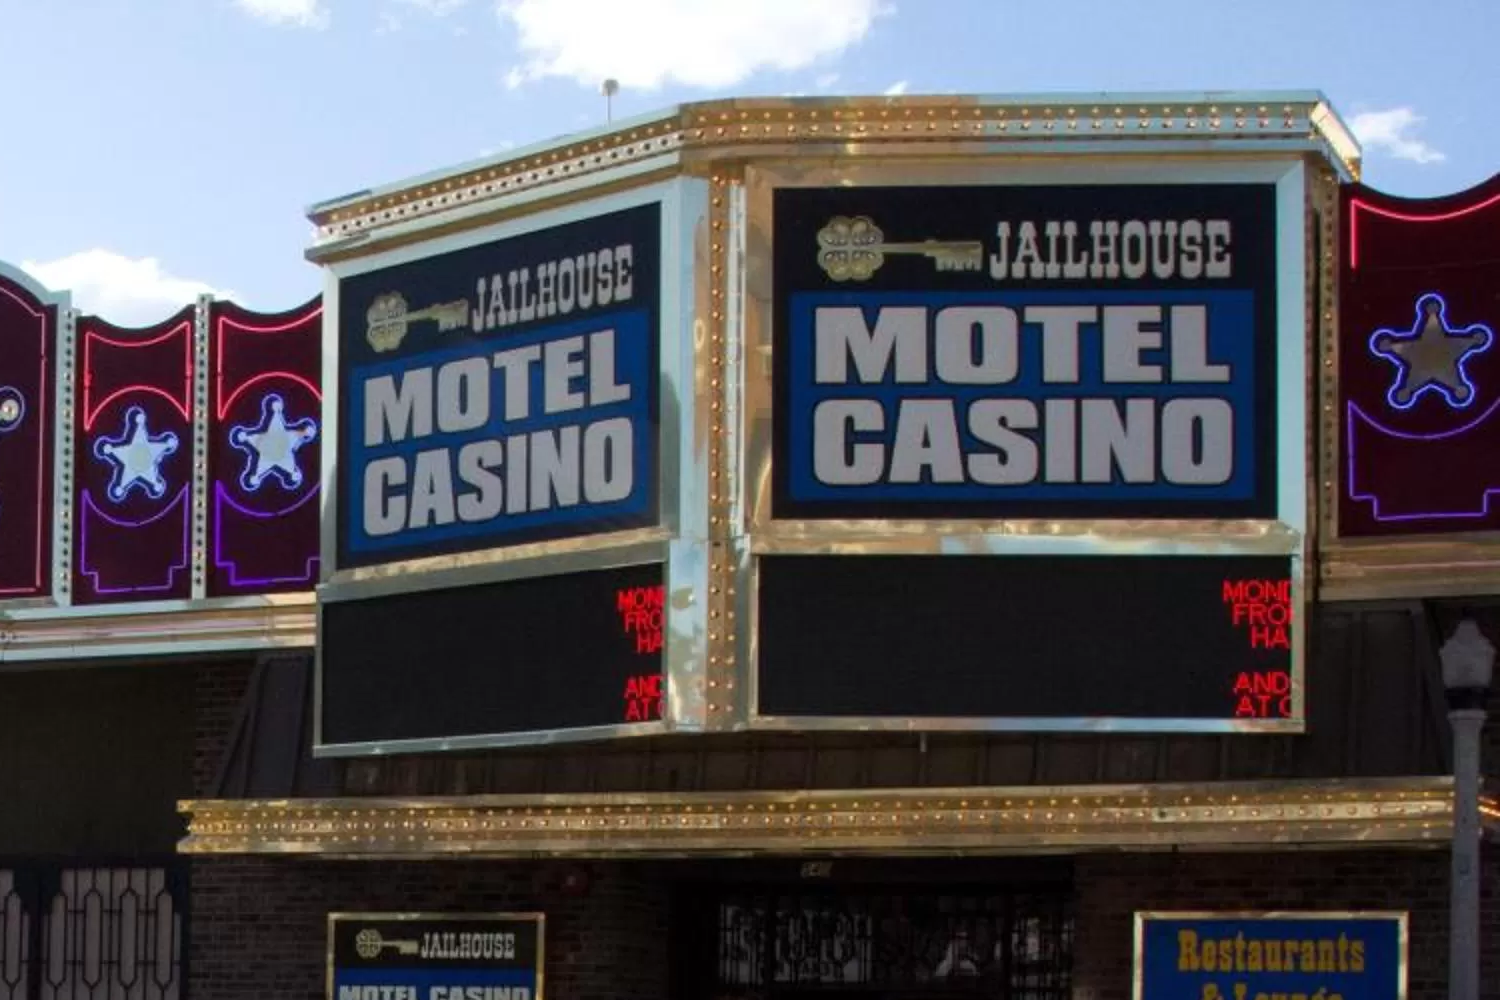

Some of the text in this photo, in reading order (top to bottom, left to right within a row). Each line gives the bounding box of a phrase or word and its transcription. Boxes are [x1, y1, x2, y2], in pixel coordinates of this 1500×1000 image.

[989, 220, 1232, 280] JAILHOUSE
[471, 243, 634, 333] JAILHOUSE
[815, 305, 1231, 384] MOTEL
[363, 328, 631, 448] MOTEL
[813, 397, 1233, 485] CASINO
[362, 416, 634, 538] CASINO
[1232, 603, 1293, 626] FRO
[1233, 671, 1290, 694] AND
[421, 932, 515, 960] JAILHOUSE
[1177, 929, 1364, 972] Restaurants
